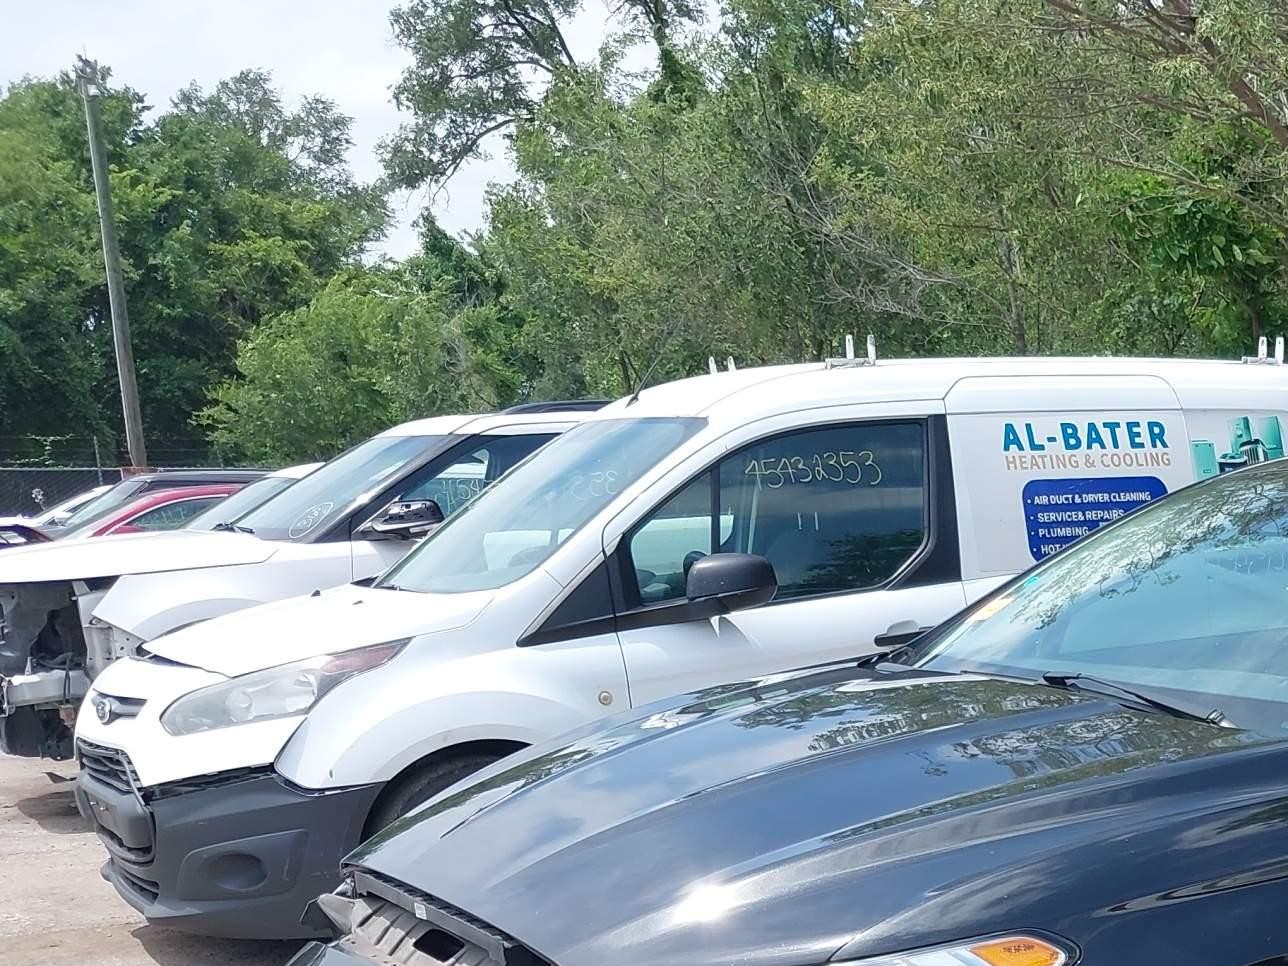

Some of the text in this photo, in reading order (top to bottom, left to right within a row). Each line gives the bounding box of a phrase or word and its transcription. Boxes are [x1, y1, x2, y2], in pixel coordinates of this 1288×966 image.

[1003, 421, 1169, 451] AL-BATER
[1005, 452, 1172, 471] HEATING & COOLING
[1033, 491, 1151, 505] AIR DUCT & DRYER CLEANING
[1085, 509, 1125, 521] REPAIRS
[1038, 526, 1089, 538] PLUMBING
